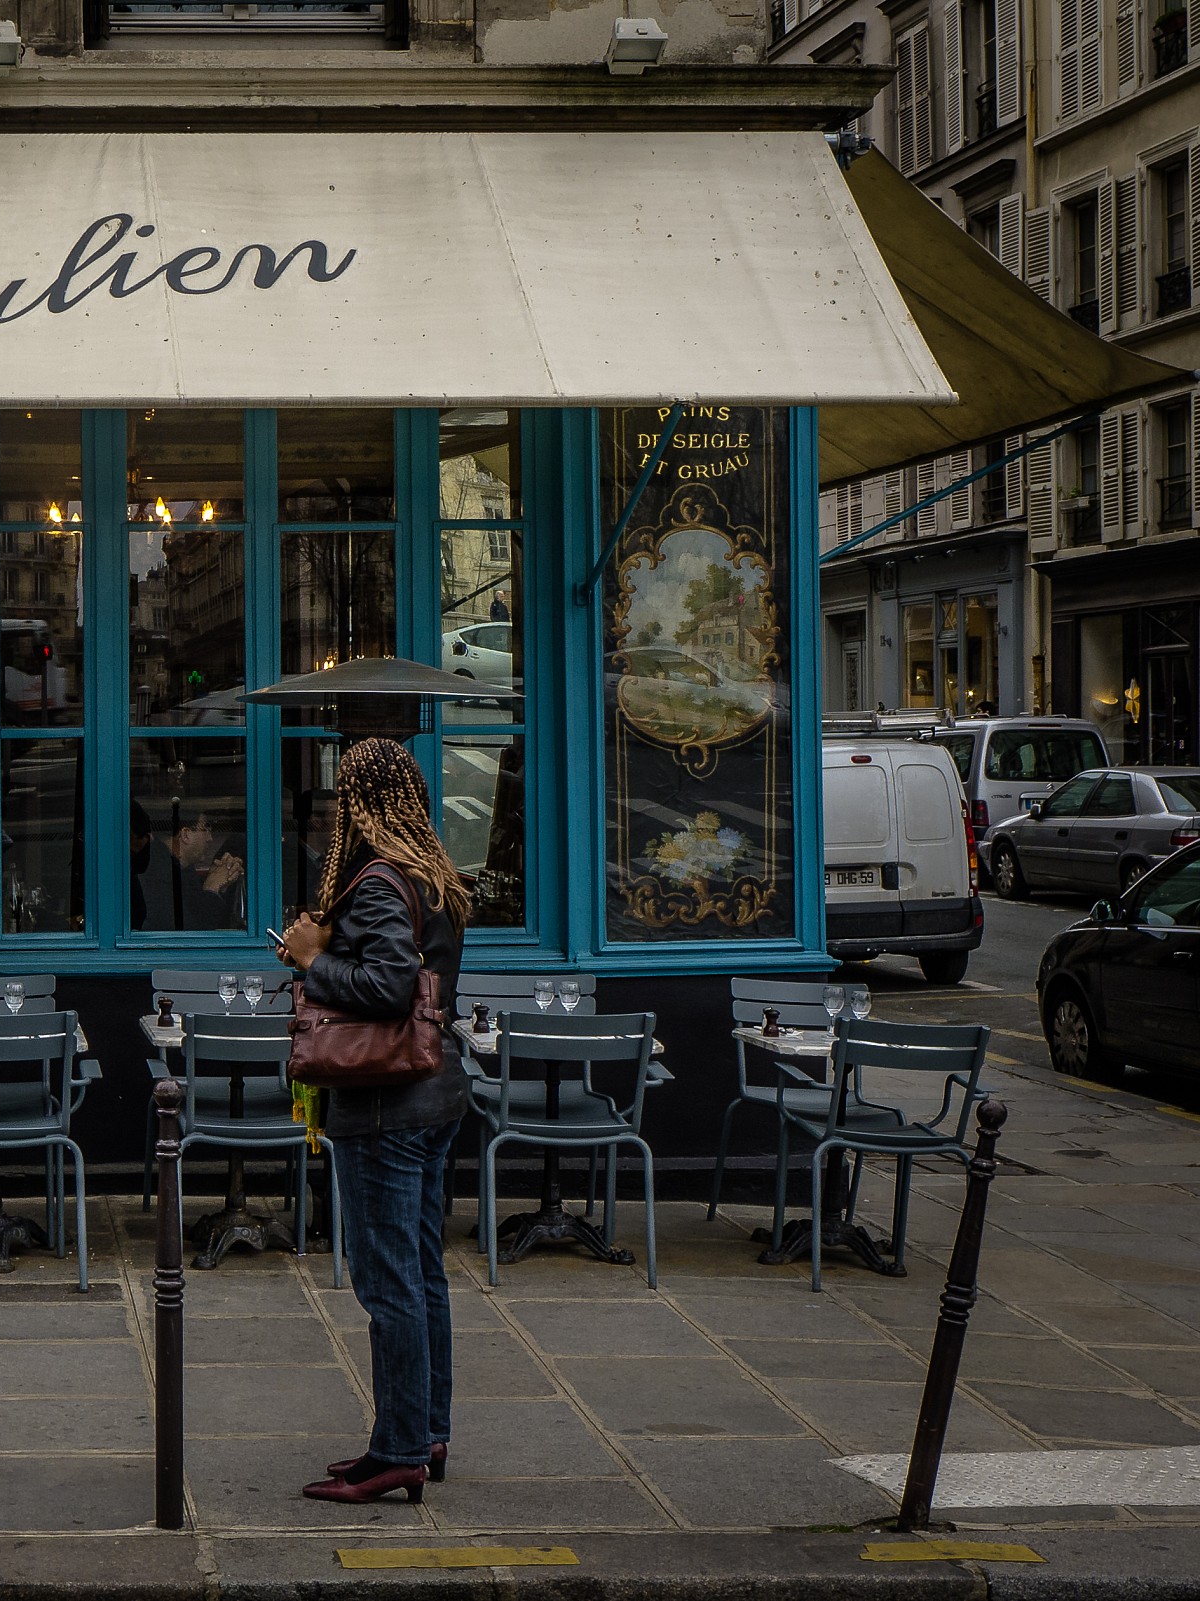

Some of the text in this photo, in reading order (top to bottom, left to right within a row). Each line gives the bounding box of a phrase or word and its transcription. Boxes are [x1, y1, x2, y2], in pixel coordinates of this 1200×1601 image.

[673, 433, 751, 449] SEIGLE
[678, 451, 750, 480] GRUAU
[859, 871, 874, 884] 59
